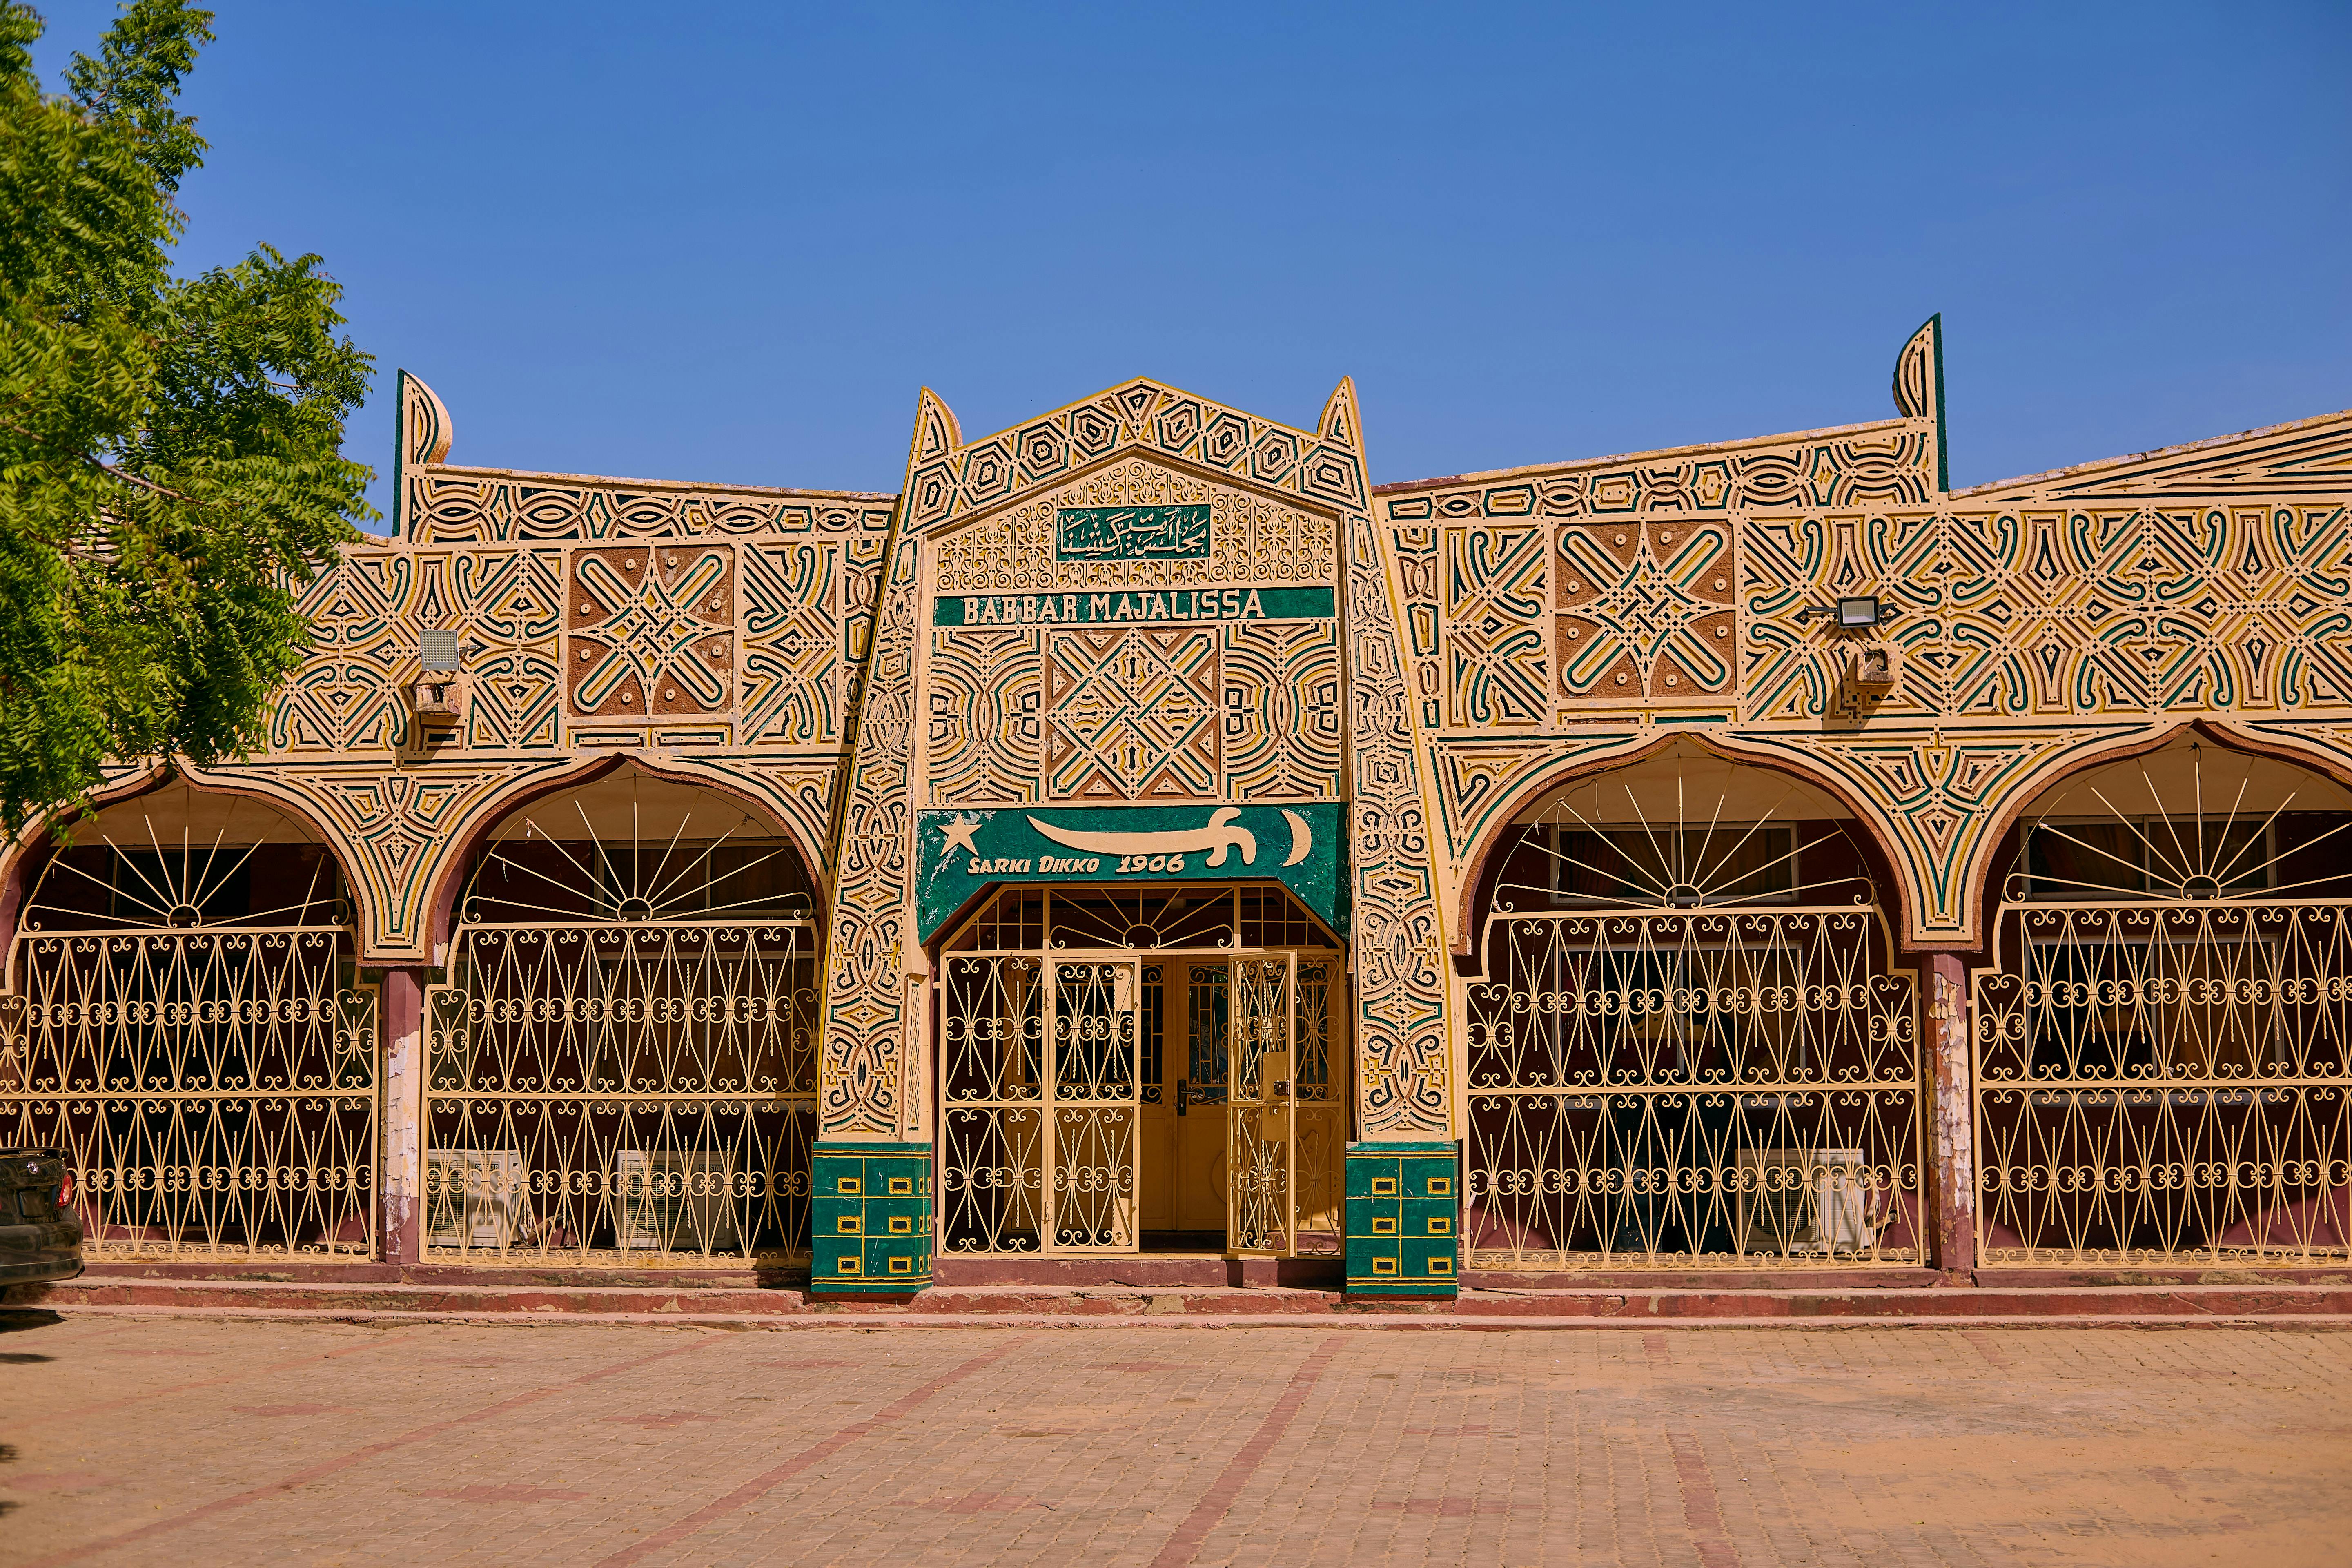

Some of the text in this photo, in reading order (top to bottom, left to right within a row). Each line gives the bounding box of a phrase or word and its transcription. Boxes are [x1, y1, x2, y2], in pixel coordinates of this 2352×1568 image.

[963, 589, 1265, 624] BABBAR MAJALISSA
[967, 853, 1185, 874] SARKI DIKKO 1906
